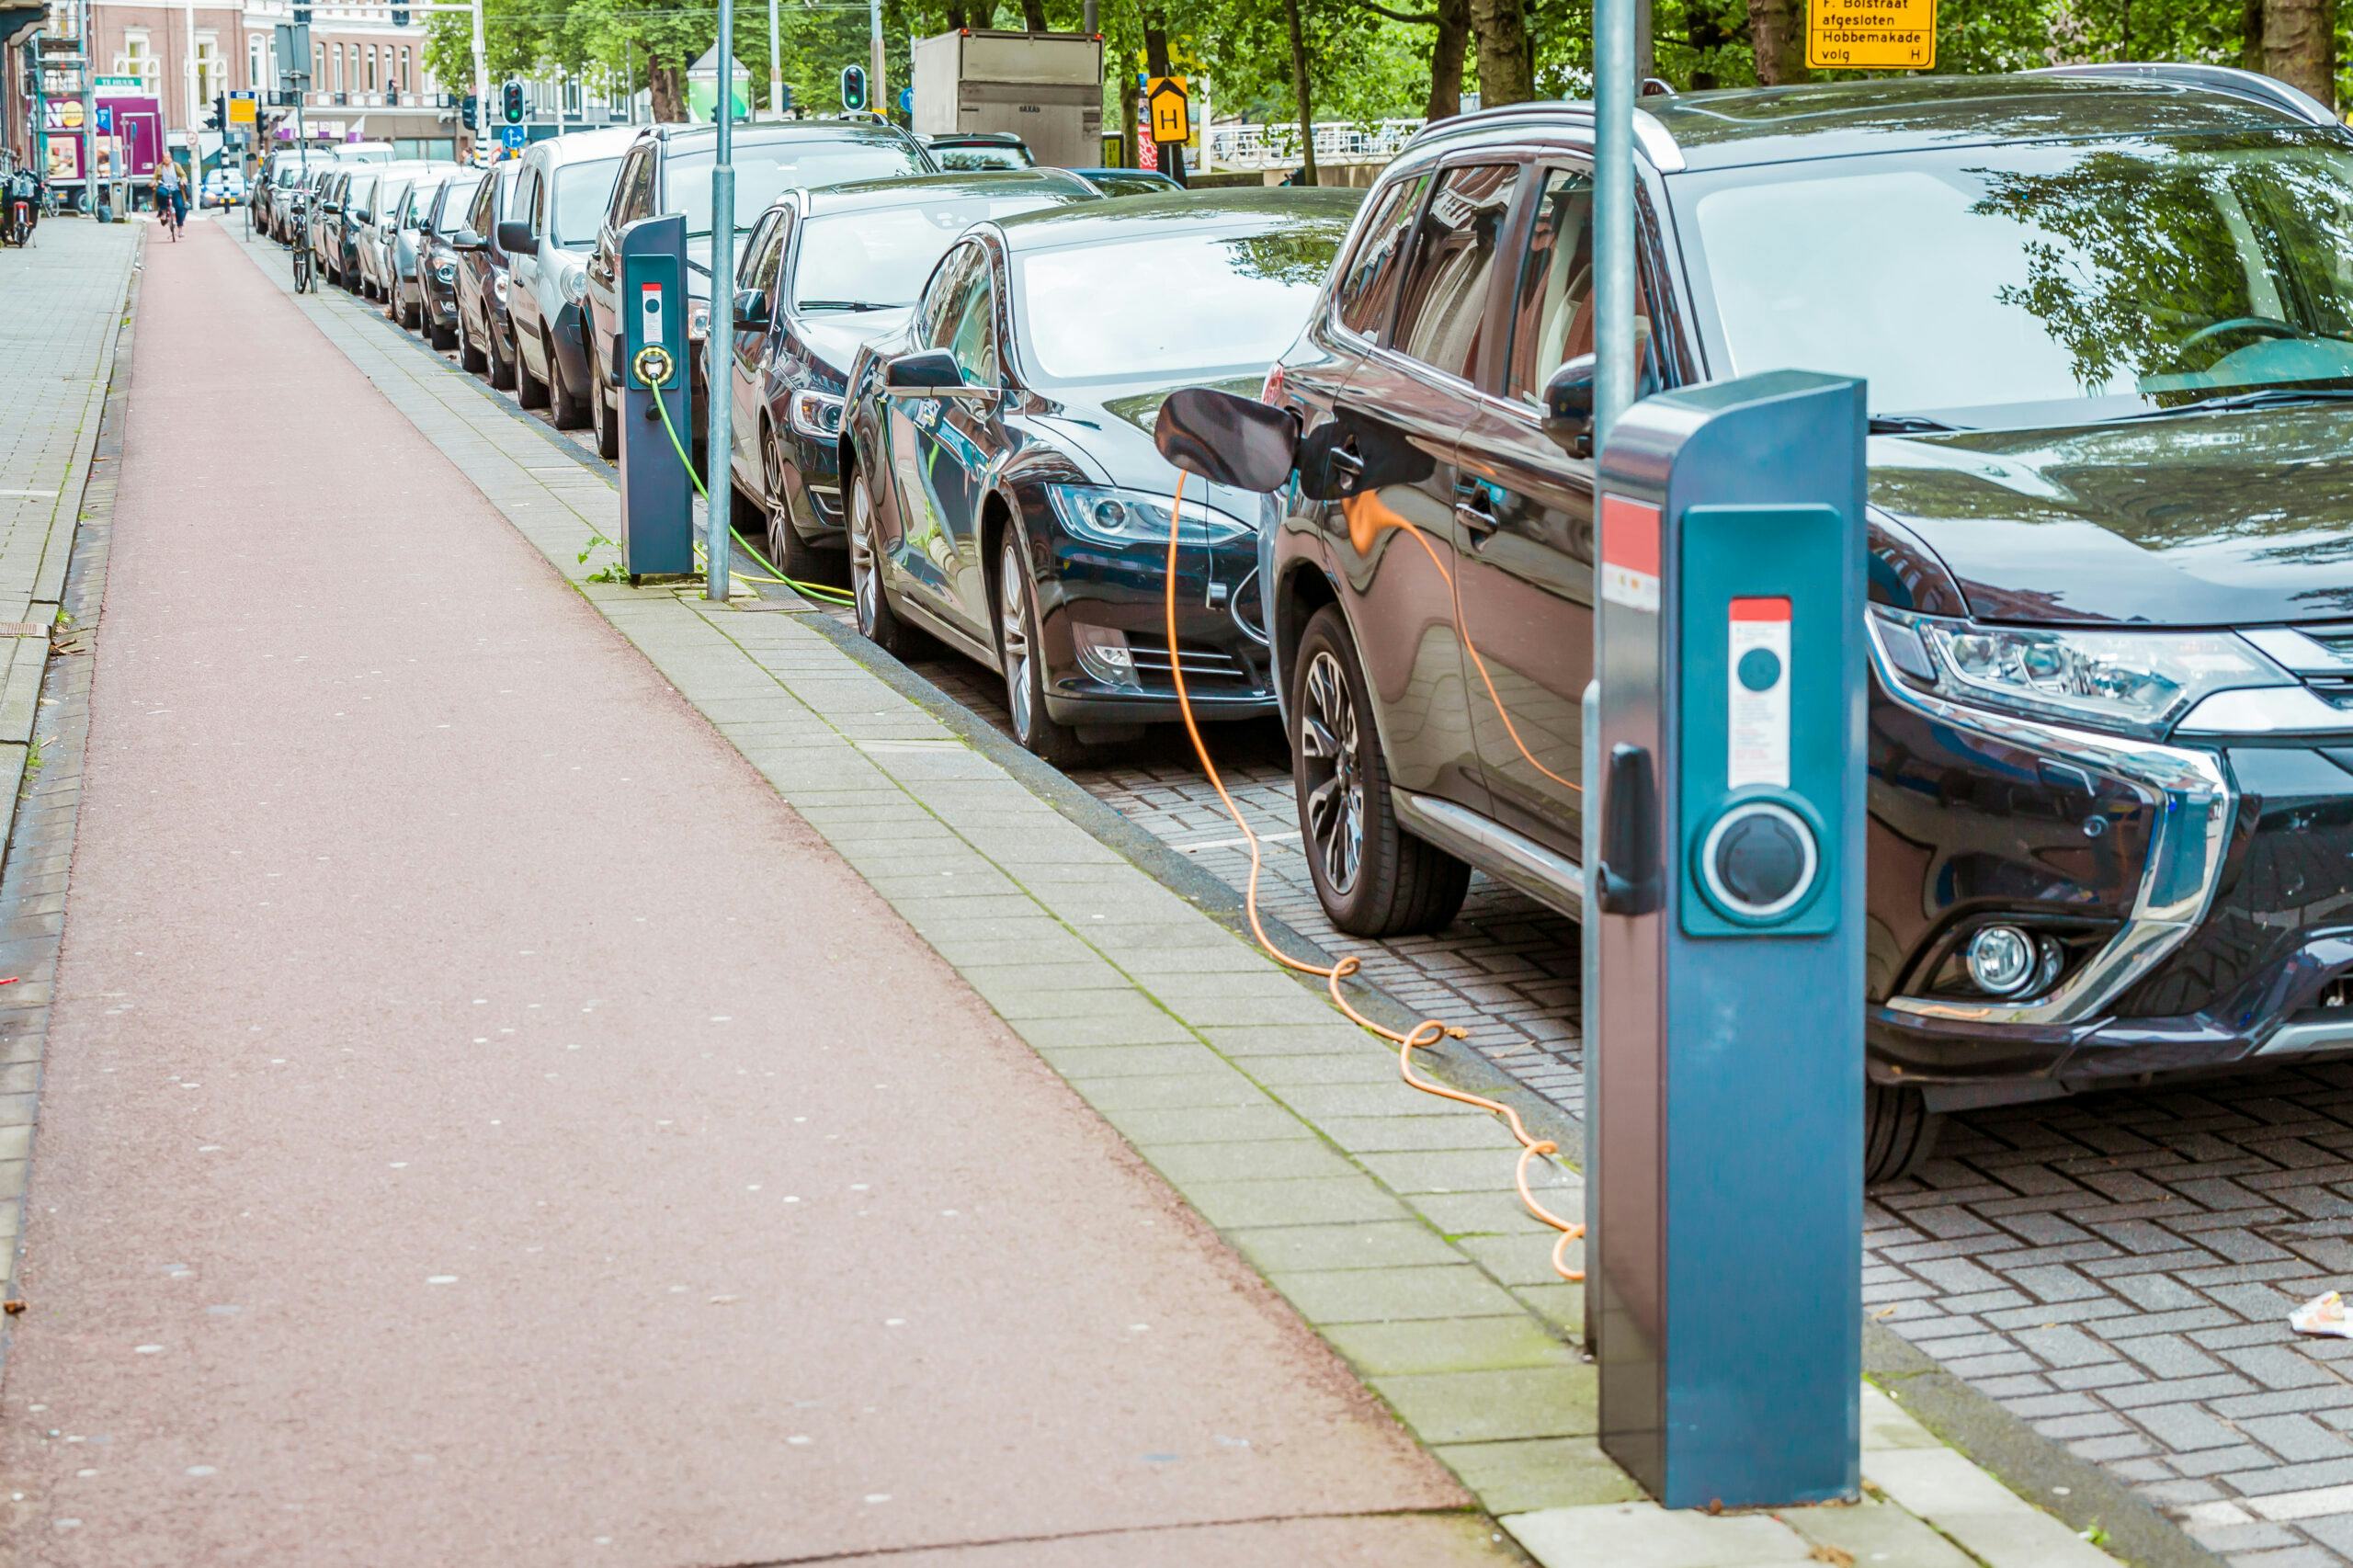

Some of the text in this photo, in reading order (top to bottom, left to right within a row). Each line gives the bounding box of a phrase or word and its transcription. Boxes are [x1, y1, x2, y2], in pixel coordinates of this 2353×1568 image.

[1844, 0, 1907, 8] Bolstraat
[1823, 14, 1894, 29] afgesloten
[1823, 30, 1921, 43] Hobbemakade
[1822, 48, 1920, 63] volg H
[1161, 108, 1177, 130] H
